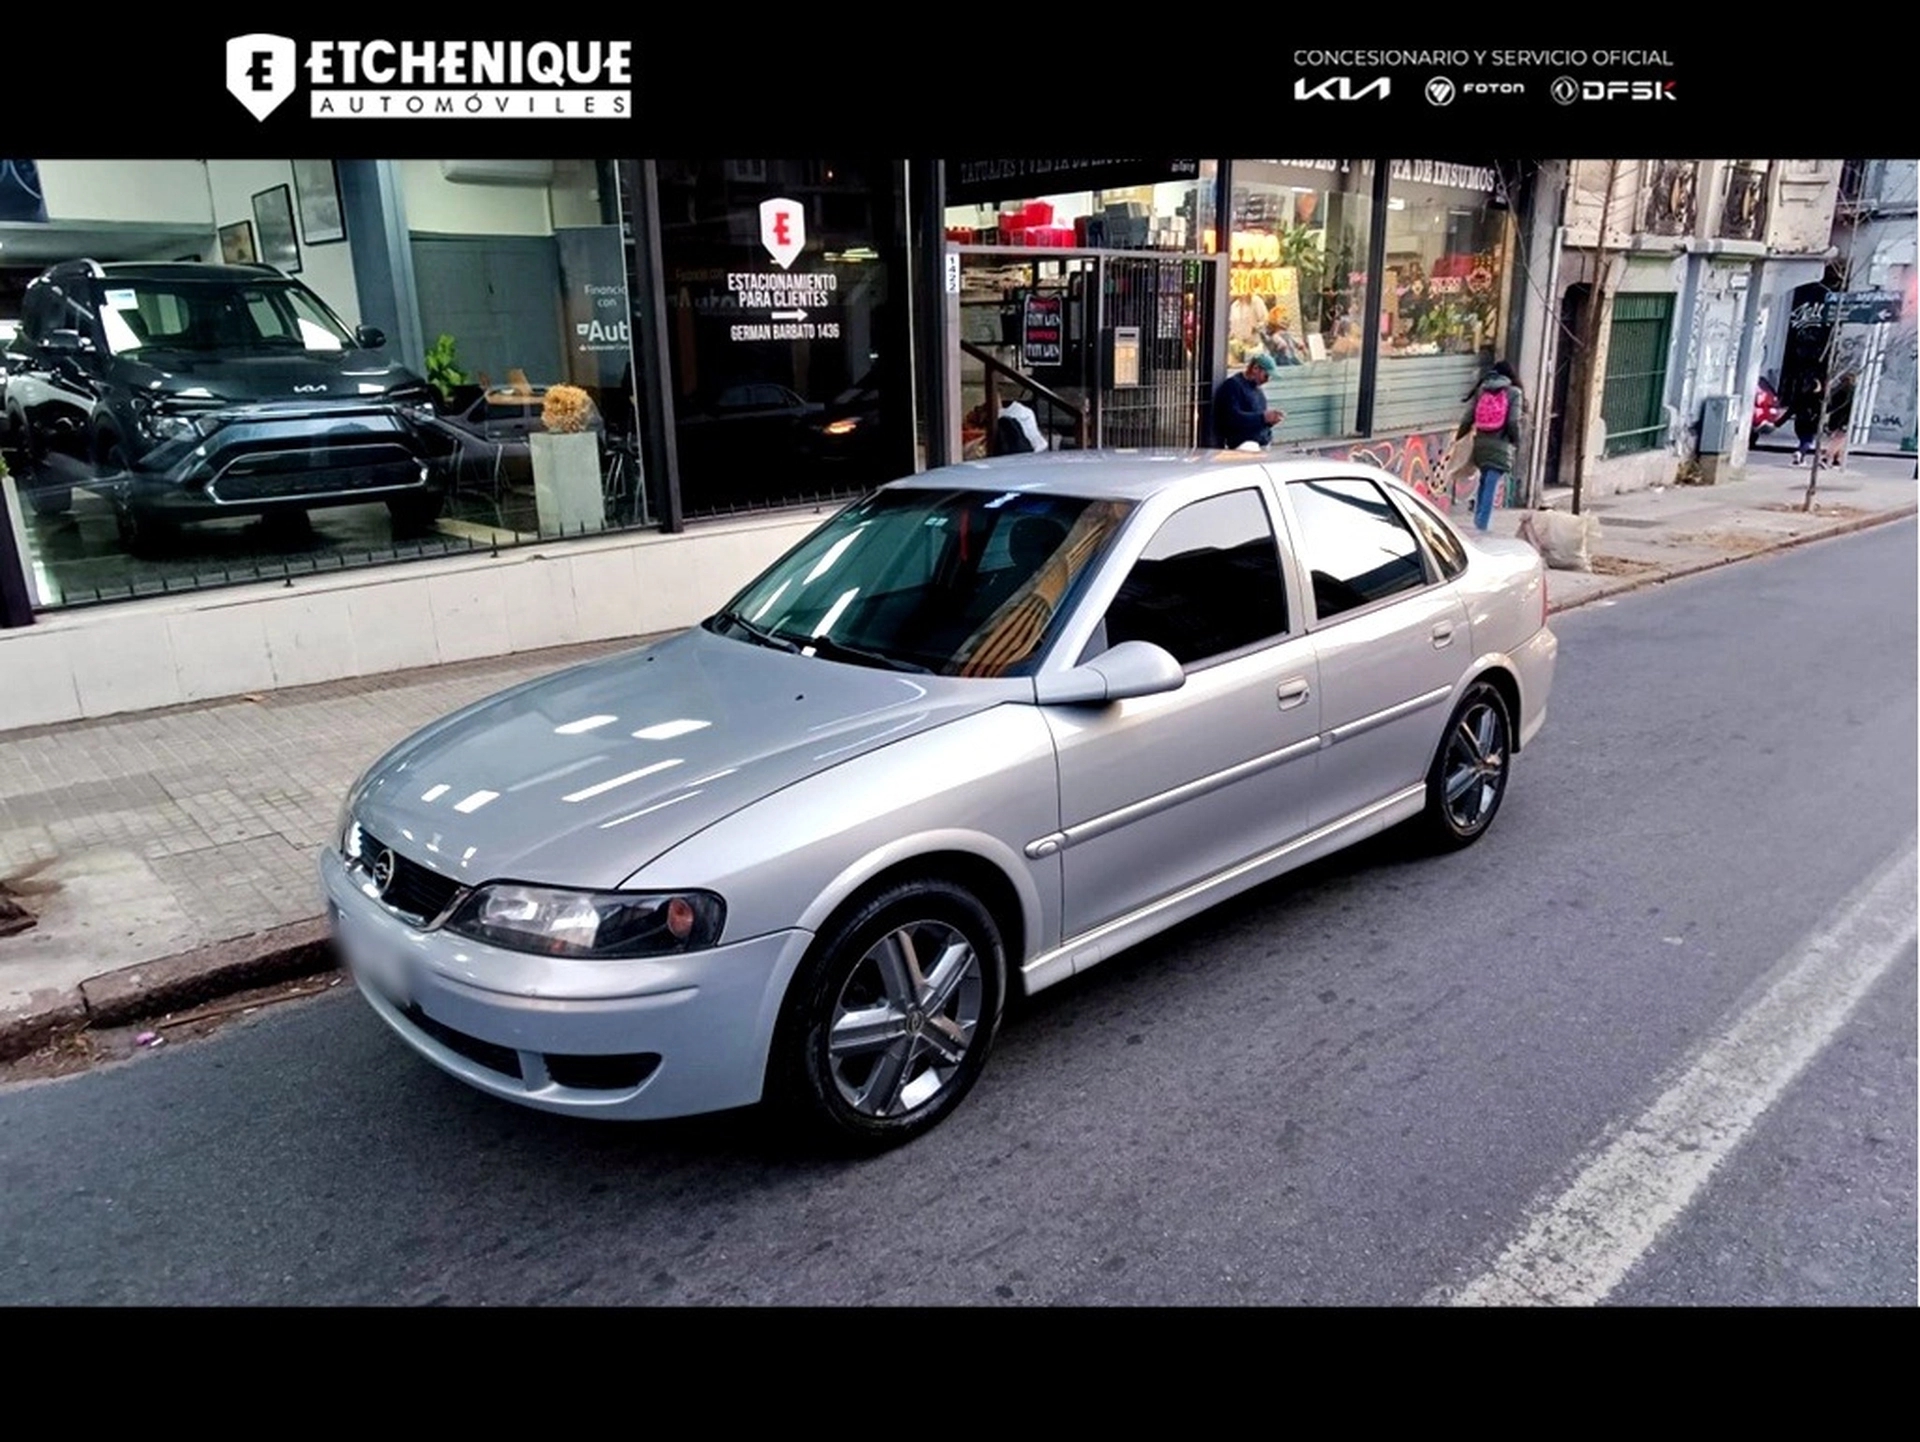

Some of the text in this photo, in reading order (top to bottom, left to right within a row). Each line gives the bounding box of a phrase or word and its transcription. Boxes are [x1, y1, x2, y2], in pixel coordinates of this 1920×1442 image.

[1433, 161, 1496, 192] INSUMOS
[727, 273, 837, 291] ESTACIONAMIENTO
[739, 290, 829, 308] PARA CLIENTES
[730, 323, 840, 341] GERMAN BARBATO 1436
